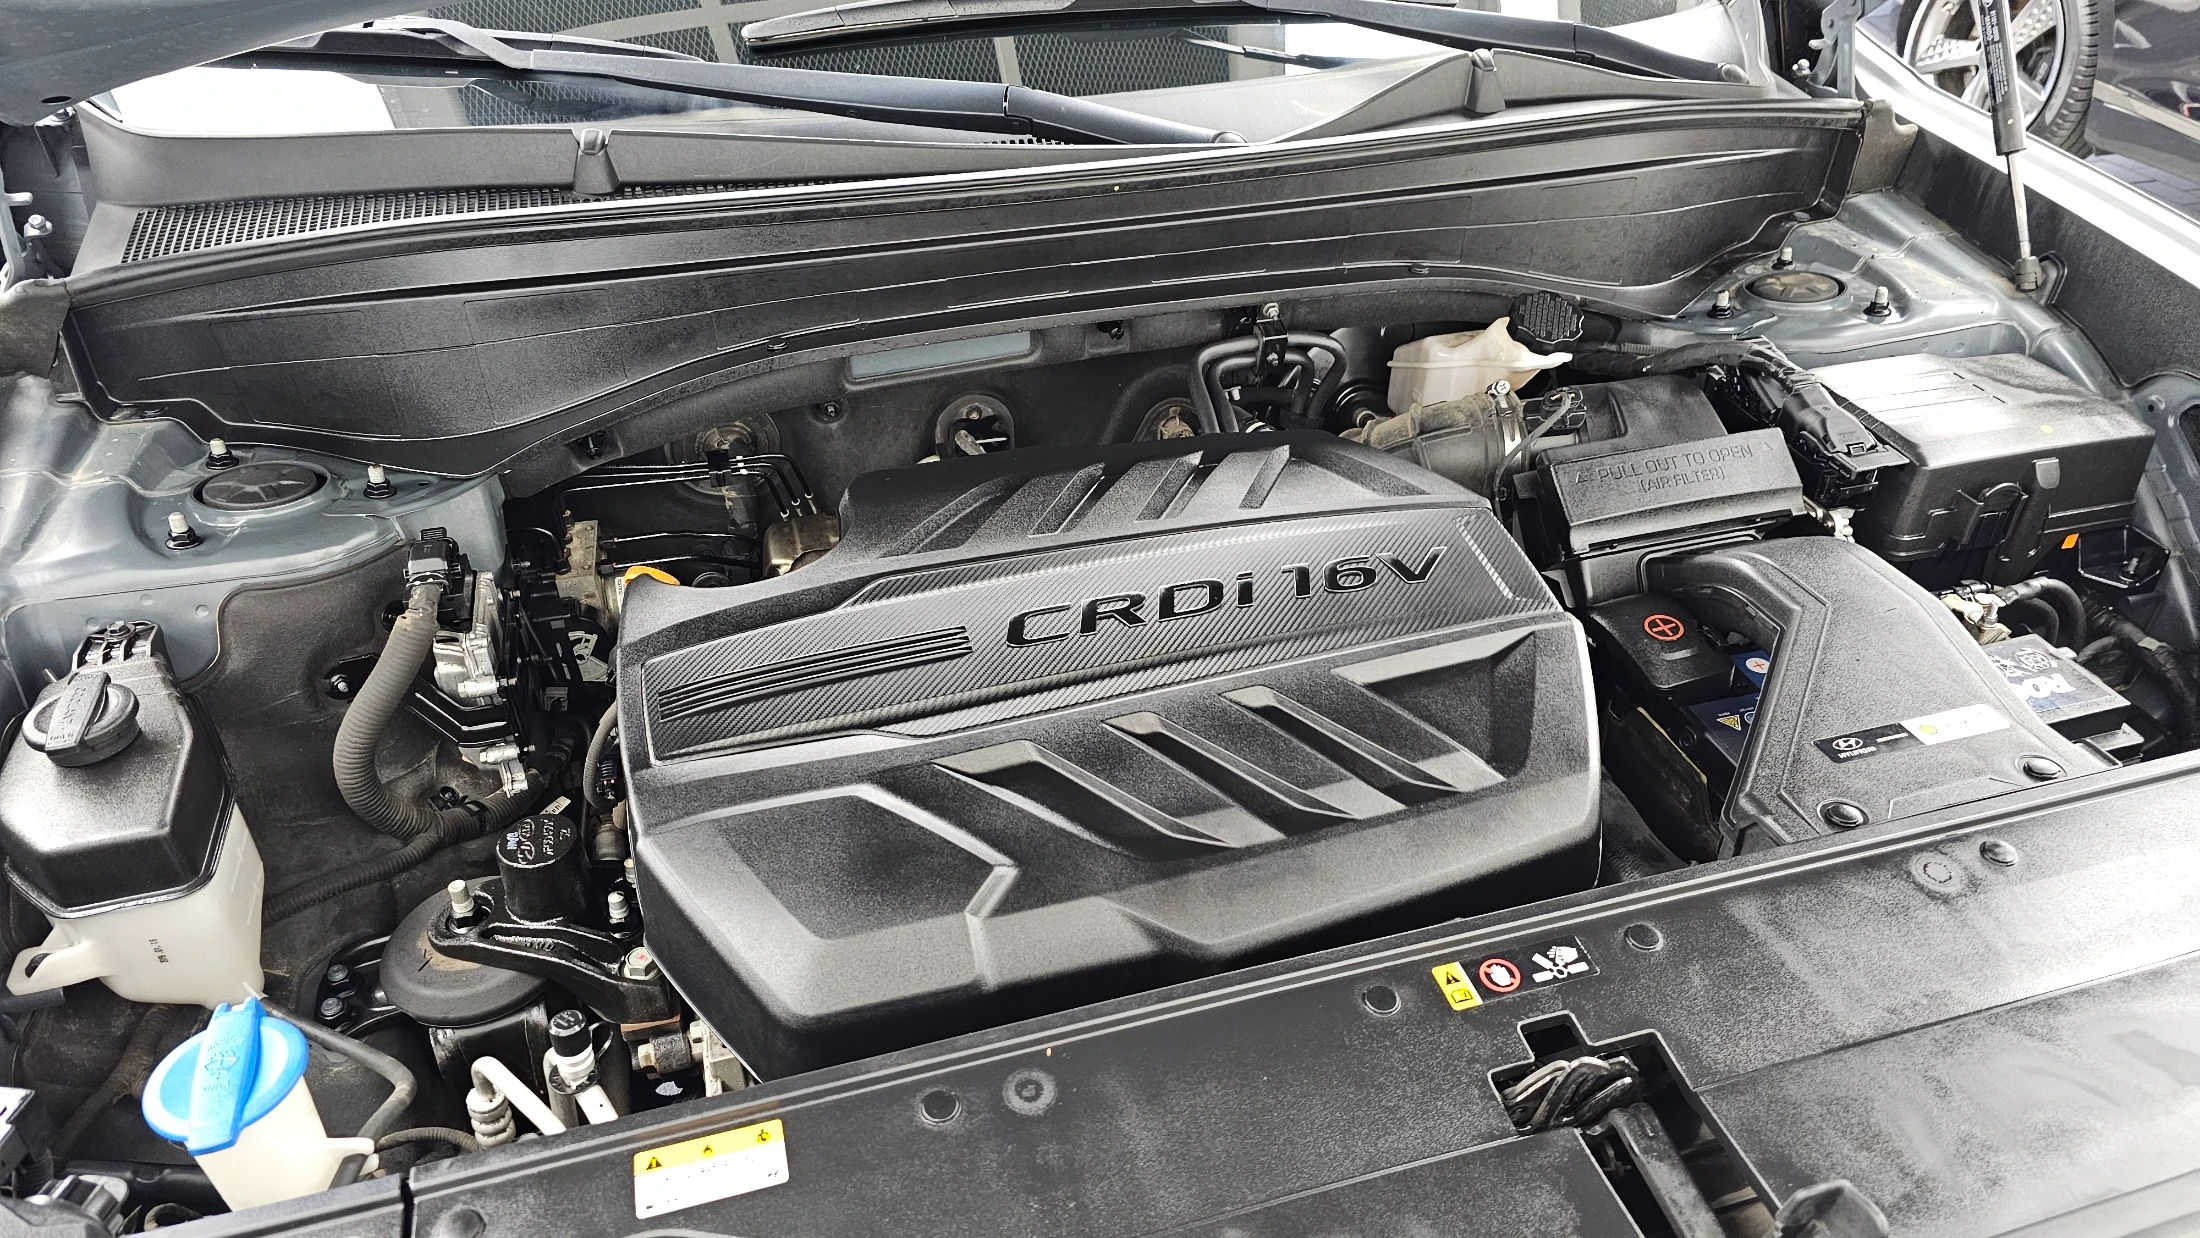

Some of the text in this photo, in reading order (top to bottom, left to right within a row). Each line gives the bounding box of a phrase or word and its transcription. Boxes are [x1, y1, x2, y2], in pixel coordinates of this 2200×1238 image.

[1596, 444, 1753, 483] PULL OUT TO OPEN
[1640, 466, 1726, 492] (AIR FILTER)
[1006, 546, 1448, 648] CRDi 16V
[1837, 746, 1877, 759] HYUNDAI
